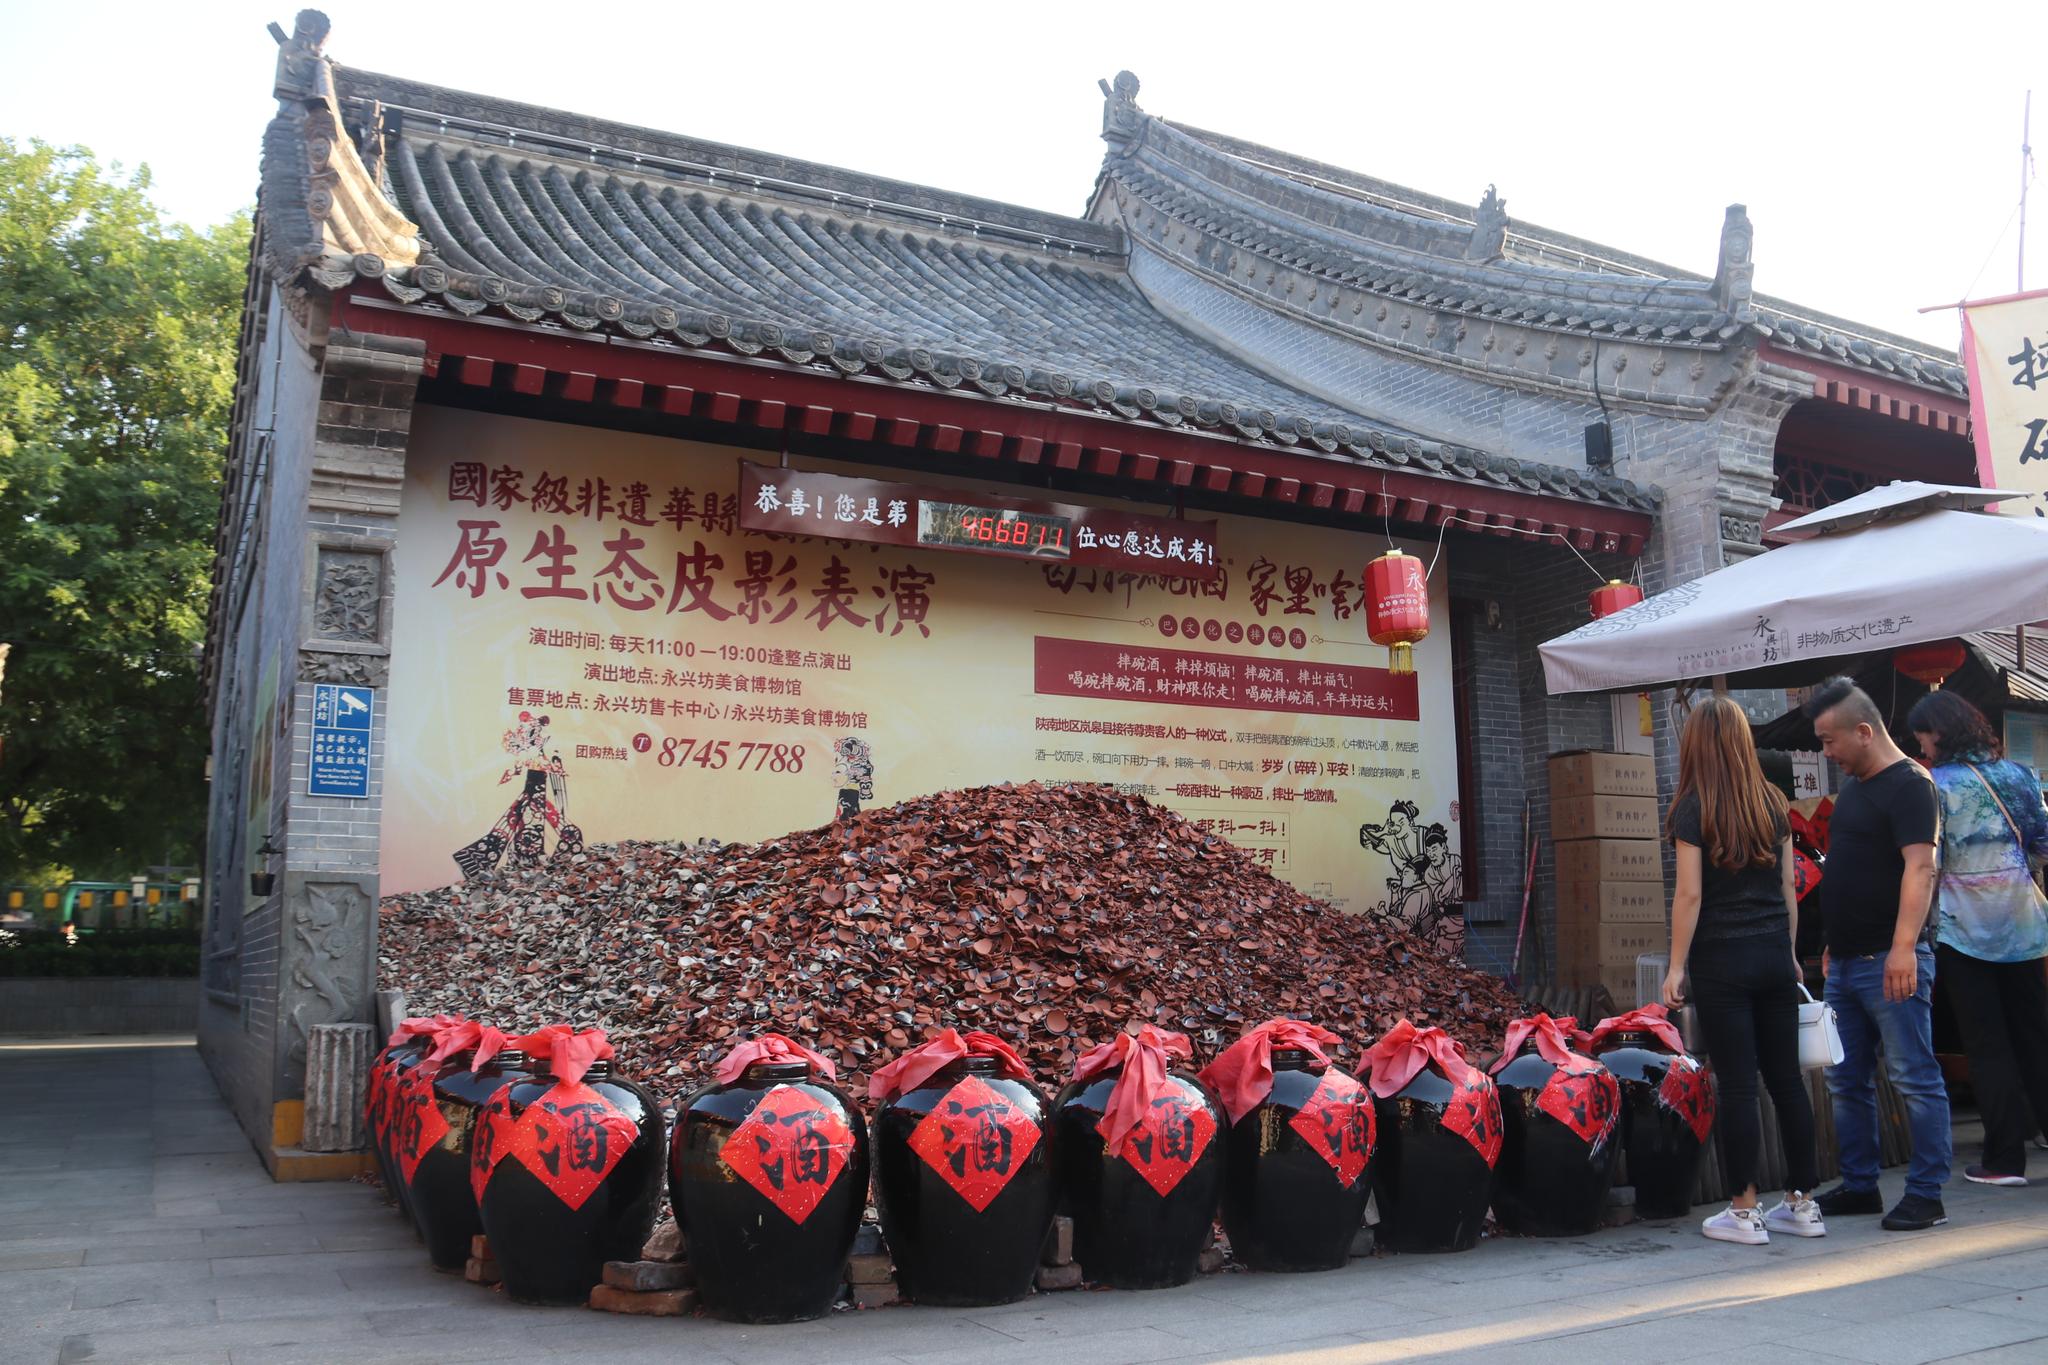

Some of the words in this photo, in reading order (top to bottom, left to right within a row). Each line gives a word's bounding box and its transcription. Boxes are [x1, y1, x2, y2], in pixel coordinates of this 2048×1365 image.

[754, 484, 908, 528] 恭喜！您是第
[962, 515, 1063, 548] 466811
[1076, 525, 1214, 565] 位心愿达成者！
[432, 519, 936, 639] 原生态皮影表演
[1246, 556, 1364, 621] 家里啥
[1162, 619, 1303, 645] 巴文化之摔碗酒
[1797, 615, 1912, 649] 非物质文化遗产
[576, 744, 629, 761] 团购热线
[535, 1101, 608, 1178] 酒
[755, 1110, 830, 1191] 酒
[941, 1101, 1012, 1178] 酒
[1129, 1096, 1194, 1164] 酒
[1321, 1087, 1369, 1158] 酒
